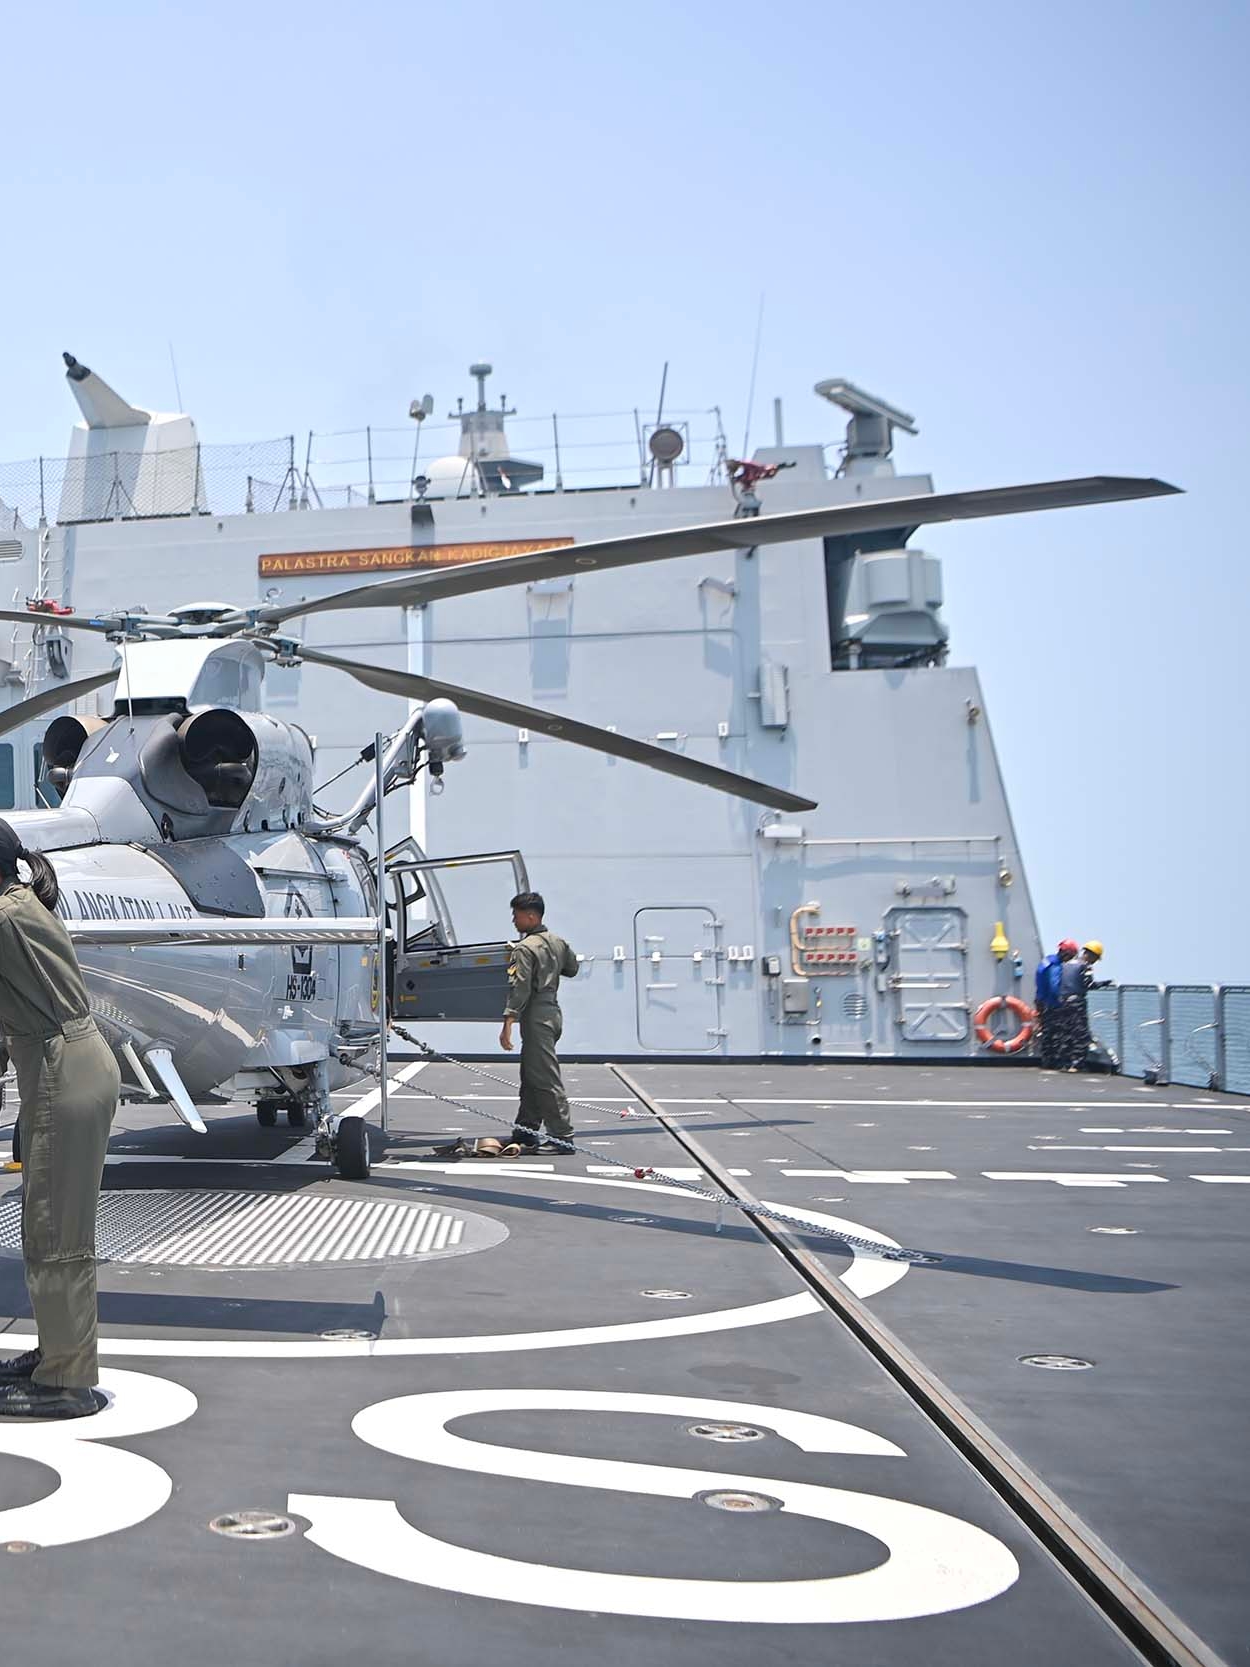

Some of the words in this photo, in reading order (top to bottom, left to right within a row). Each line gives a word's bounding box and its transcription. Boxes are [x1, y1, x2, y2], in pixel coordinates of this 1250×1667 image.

[261, 555, 350, 571] PALASTRA
[359, 549, 443, 566] SANGKAN
[73, 890, 156, 920] ANGKATAN
